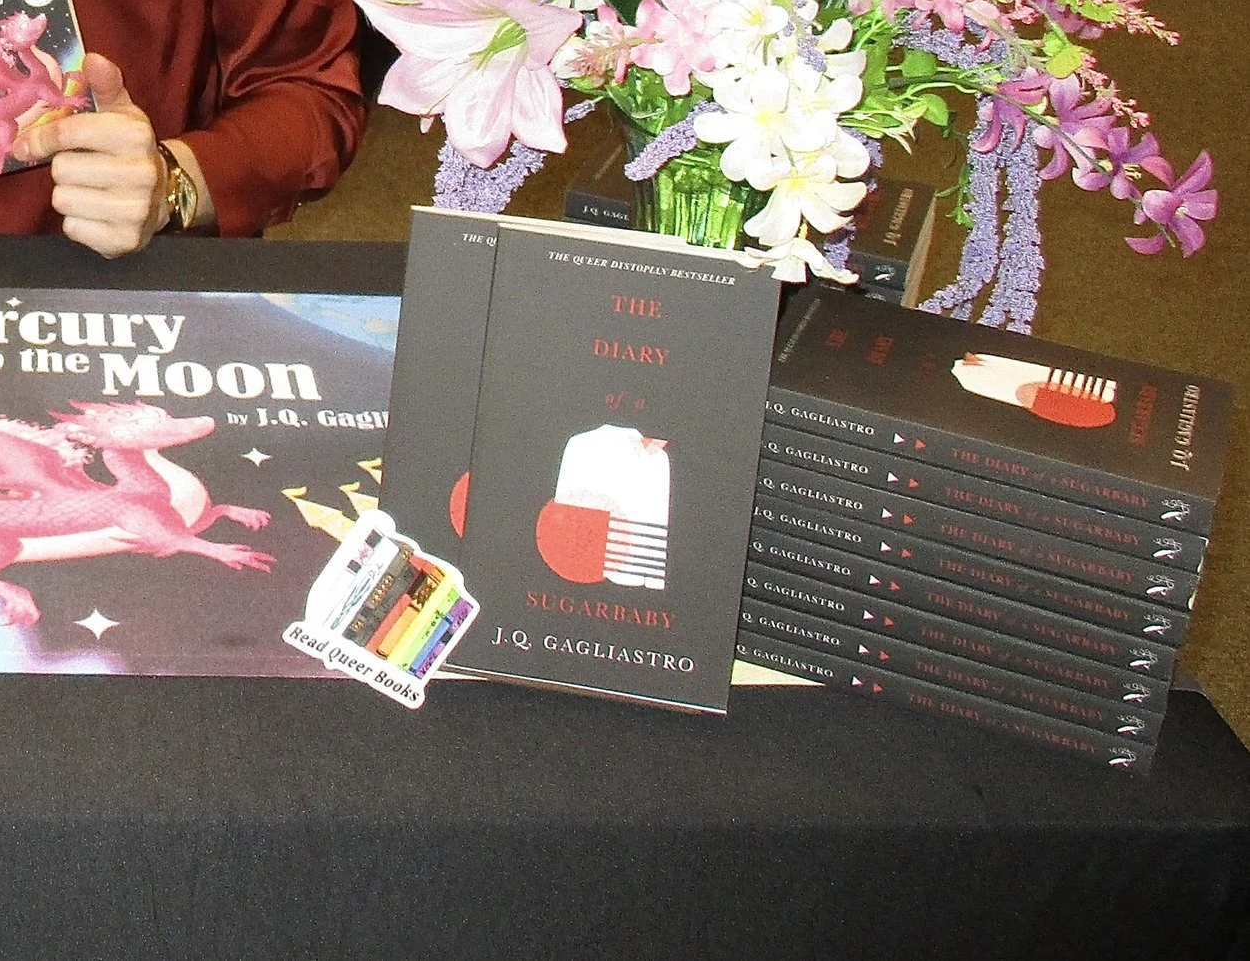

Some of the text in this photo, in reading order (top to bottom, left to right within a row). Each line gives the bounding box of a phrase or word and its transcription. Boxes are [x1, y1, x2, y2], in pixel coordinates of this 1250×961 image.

[461, 232, 484, 245] THE
[548, 250, 570, 262] THE
[573, 253, 608, 269] QUEER
[670, 268, 737, 287] BESTSELLER
[611, 294, 662, 319] THE
[593, 337, 670, 367] DIARY
[19, 348, 90, 374] the
[99, 352, 323, 402] Moon
[605, 389, 628, 412] of
[226, 407, 390, 430] by J.Q. Gagli
[790, 407, 875, 436] GAGLIASTRO
[780, 482, 863, 511] GAGLIASTRO
[779, 514, 862, 544] GAGLIASTRO
[526, 591, 678, 630] SUGARBABY
[763, 581, 846, 612] GAGLIASTRO
[491, 626, 695, 672] J.Q. GAGLIASTRO
[753, 648, 834, 679] GAGLIASTRO
[289, 626, 421, 703] Read Queer Books
